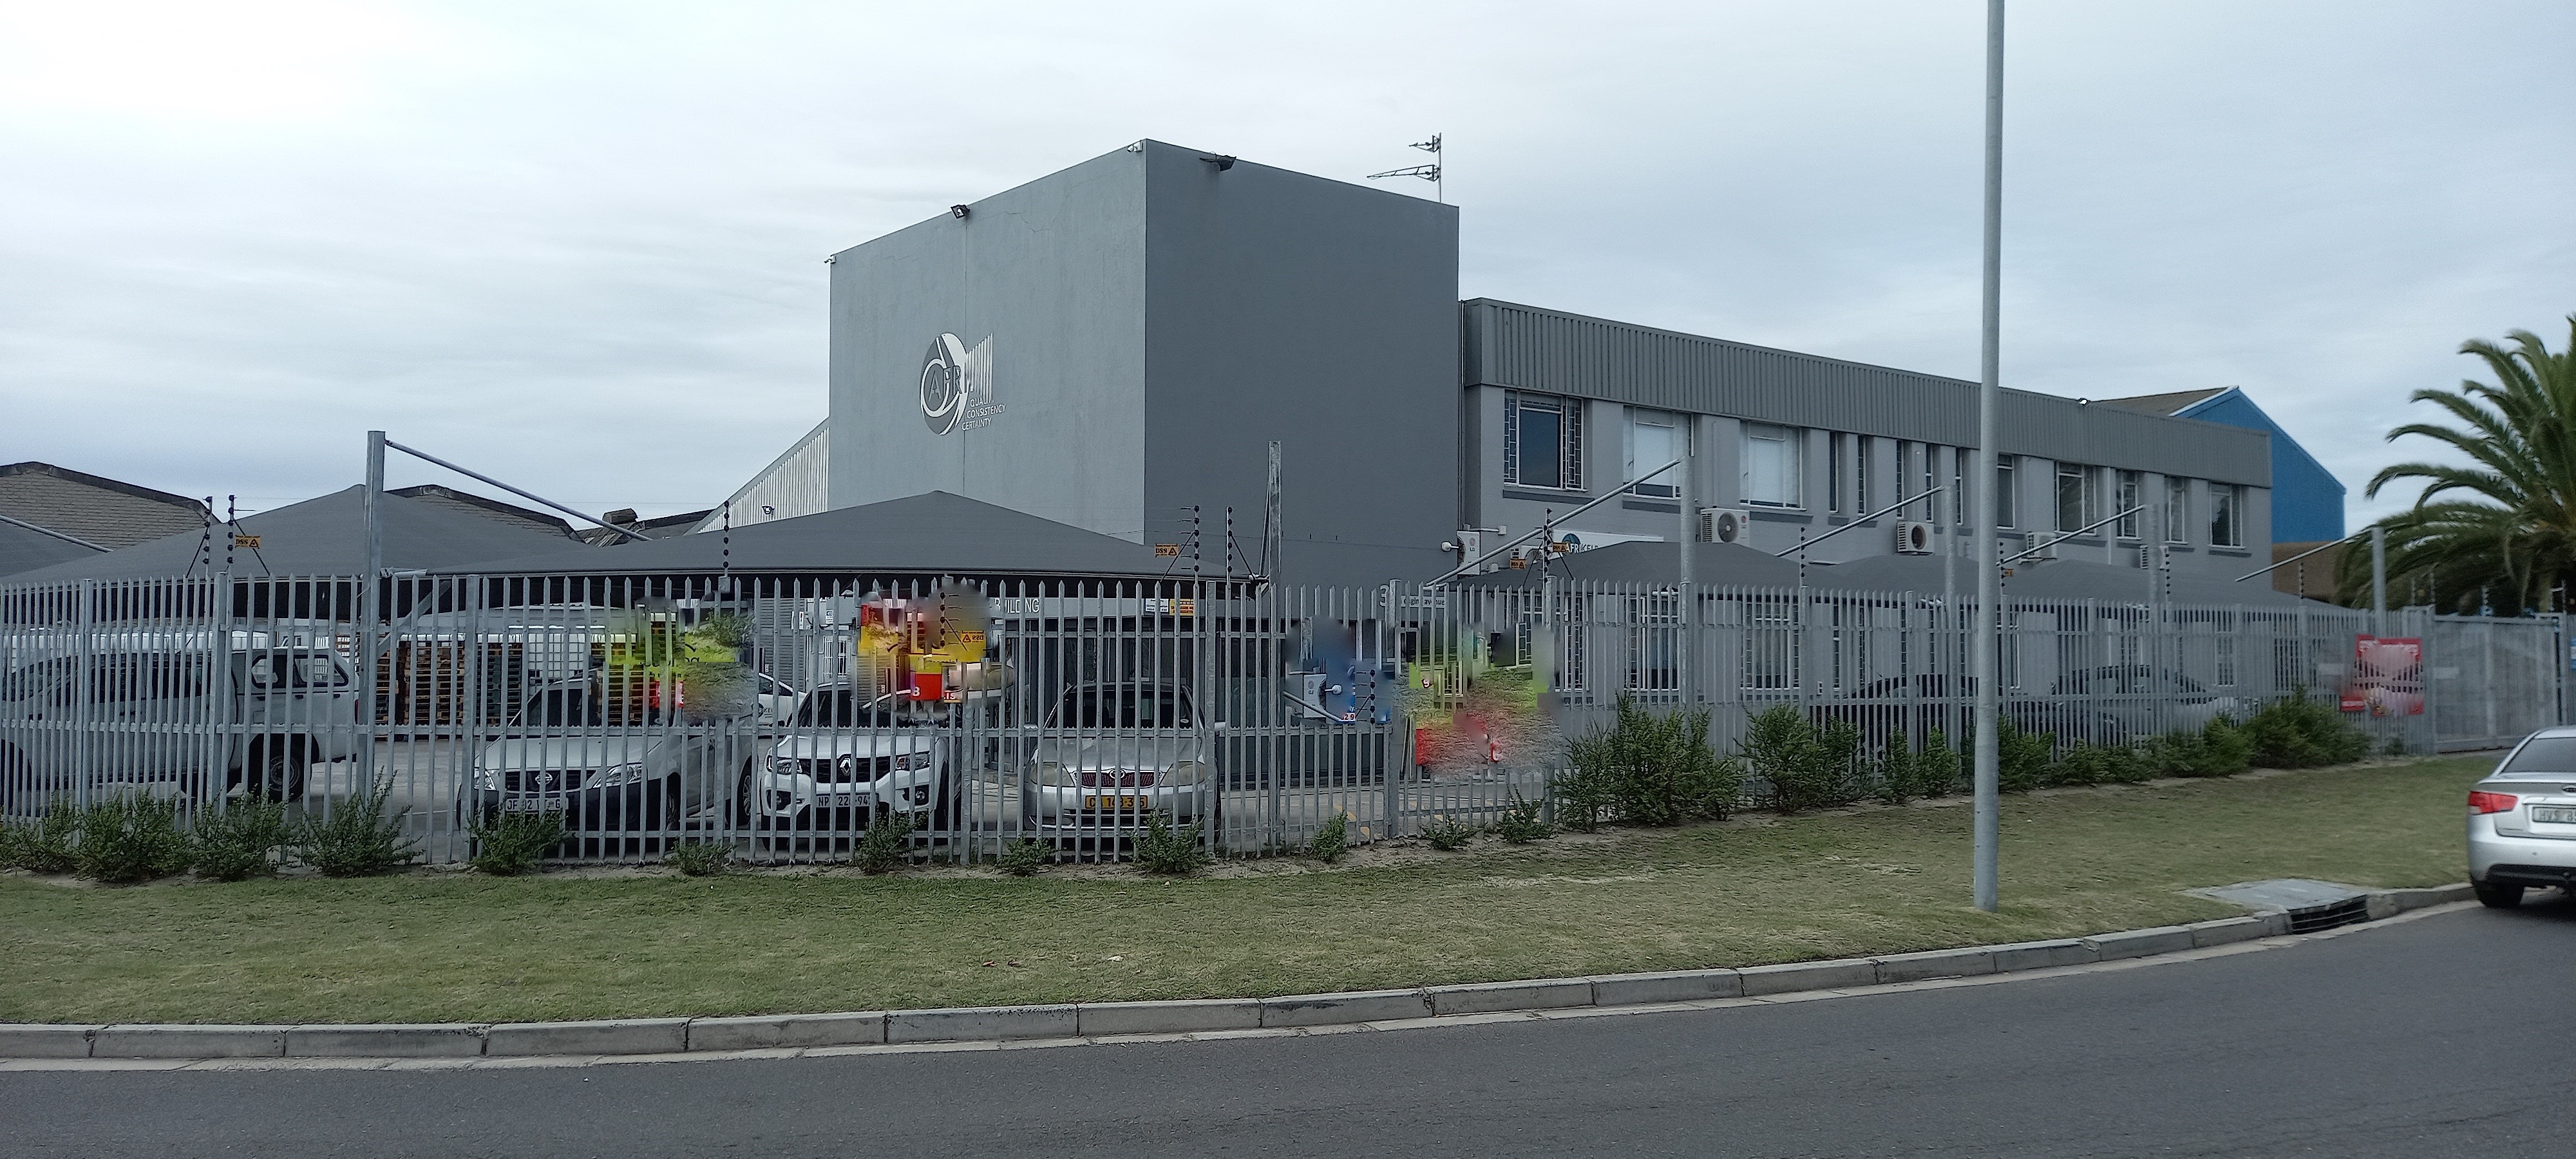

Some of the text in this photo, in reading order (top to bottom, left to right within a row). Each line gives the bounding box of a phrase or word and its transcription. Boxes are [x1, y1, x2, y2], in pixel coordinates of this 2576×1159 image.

[971, 396, 994, 408] QUAL
[967, 404, 1006, 419] CONSISTENCY
[961, 417, 992, 431] CERTAINTY
[994, 598, 1039, 614] BILDNG
[507, 800, 518, 810] JF
[819, 795, 872, 807] NP 22-94
